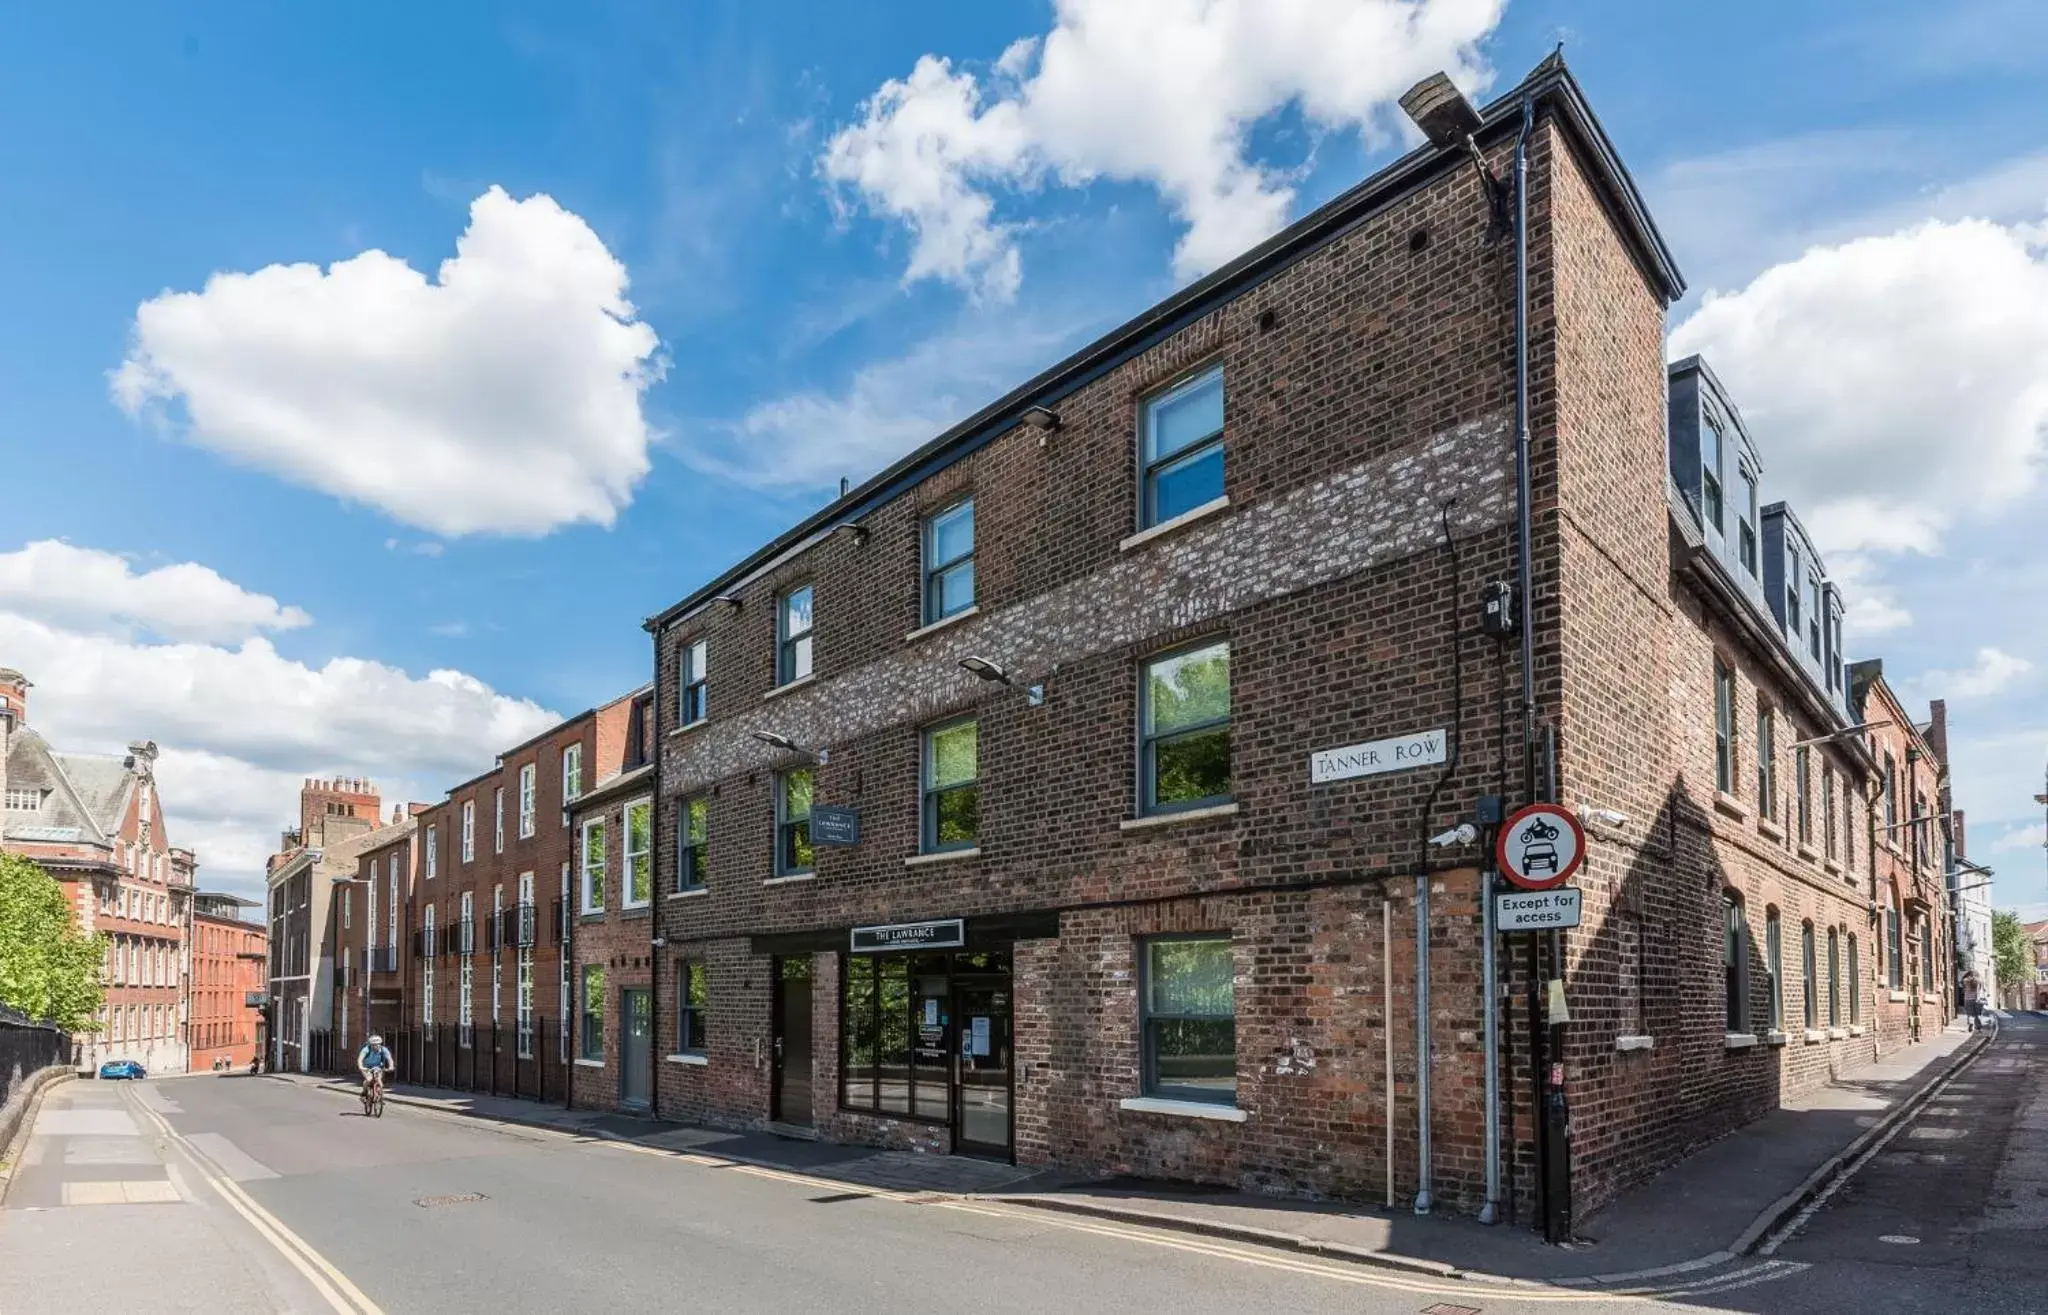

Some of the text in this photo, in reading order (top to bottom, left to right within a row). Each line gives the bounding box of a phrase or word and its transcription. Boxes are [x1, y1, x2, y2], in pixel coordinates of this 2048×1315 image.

[1317, 739, 1440, 774] TANNER ROW
[1502, 895, 1575, 910] Except for
[1515, 912, 1562, 923] access
[876, 928, 935, 940] THE LAWRANCE
